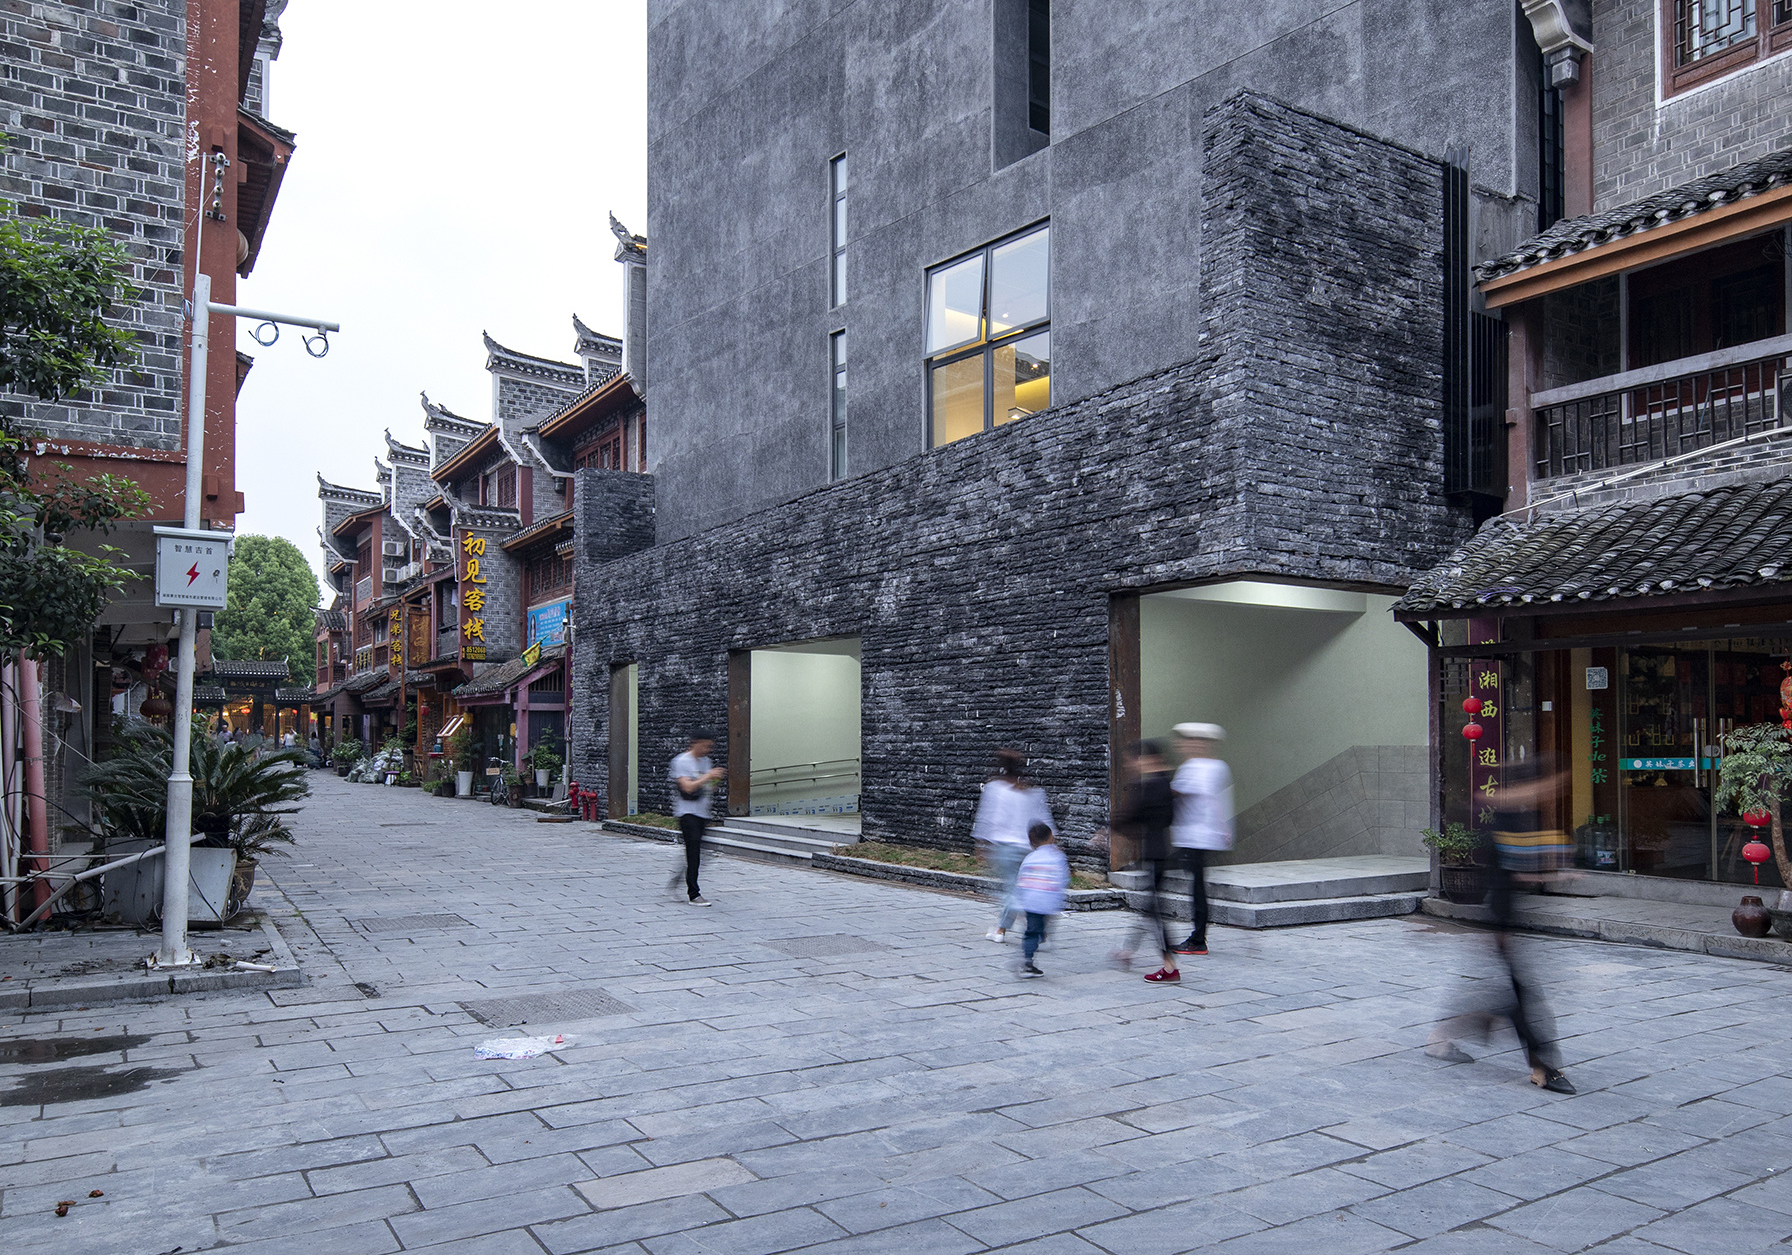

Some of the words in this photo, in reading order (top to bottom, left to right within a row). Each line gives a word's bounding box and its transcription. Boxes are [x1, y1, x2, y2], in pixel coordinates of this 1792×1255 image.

[174, 544, 213, 555] 智慧吉首
[461, 531, 487, 642] 初见客栈
[390, 609, 402, 666] 兄弟客栈
